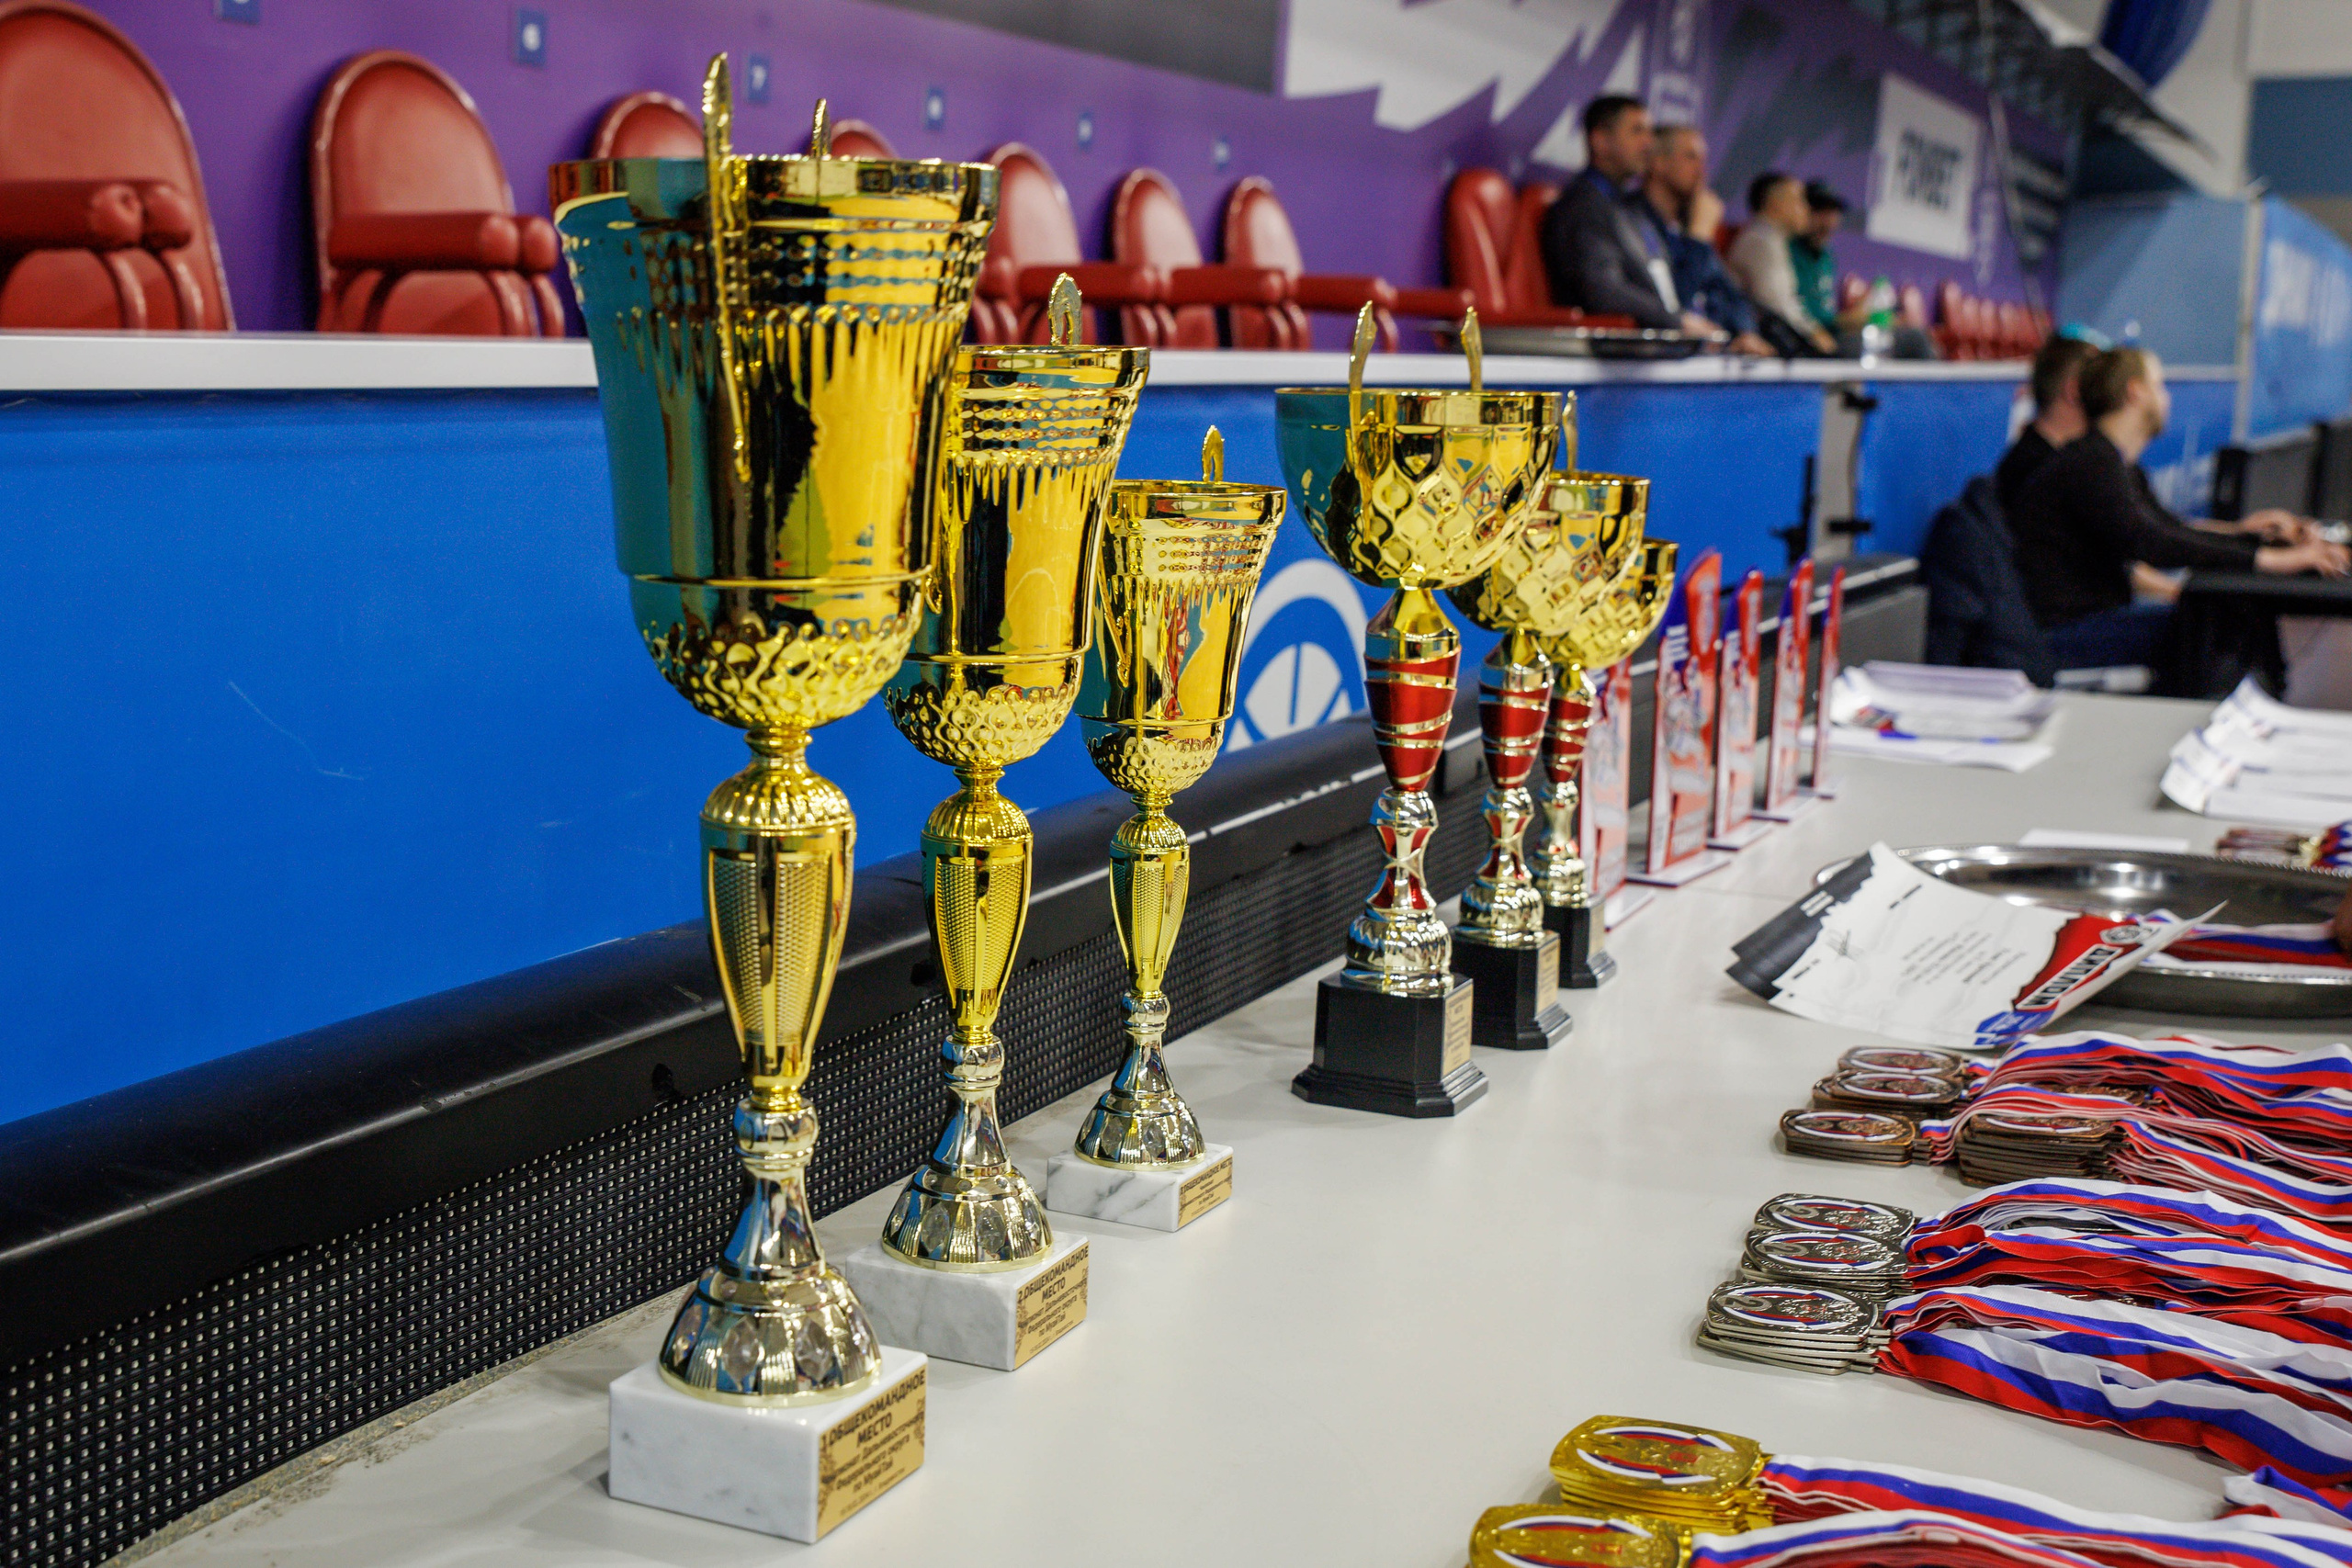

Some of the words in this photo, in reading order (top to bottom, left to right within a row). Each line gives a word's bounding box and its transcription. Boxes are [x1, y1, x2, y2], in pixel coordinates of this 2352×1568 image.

[2023, 946, 2116, 1007] ДИПЛОМ
[1775, 1205, 1810, 1217] 2
[1763, 1243, 1798, 1254] 2
[1023, 1245, 1089, 1300] ОБЩЕКОМАНДНОЕ
[1041, 1276, 1066, 1303] МЕСТО
[1724, 1296, 1759, 1308] 2
[829, 1370, 926, 1446] ОБЩЕКОМАНДНОЕ
[856, 1412, 892, 1448] МЕСТО
